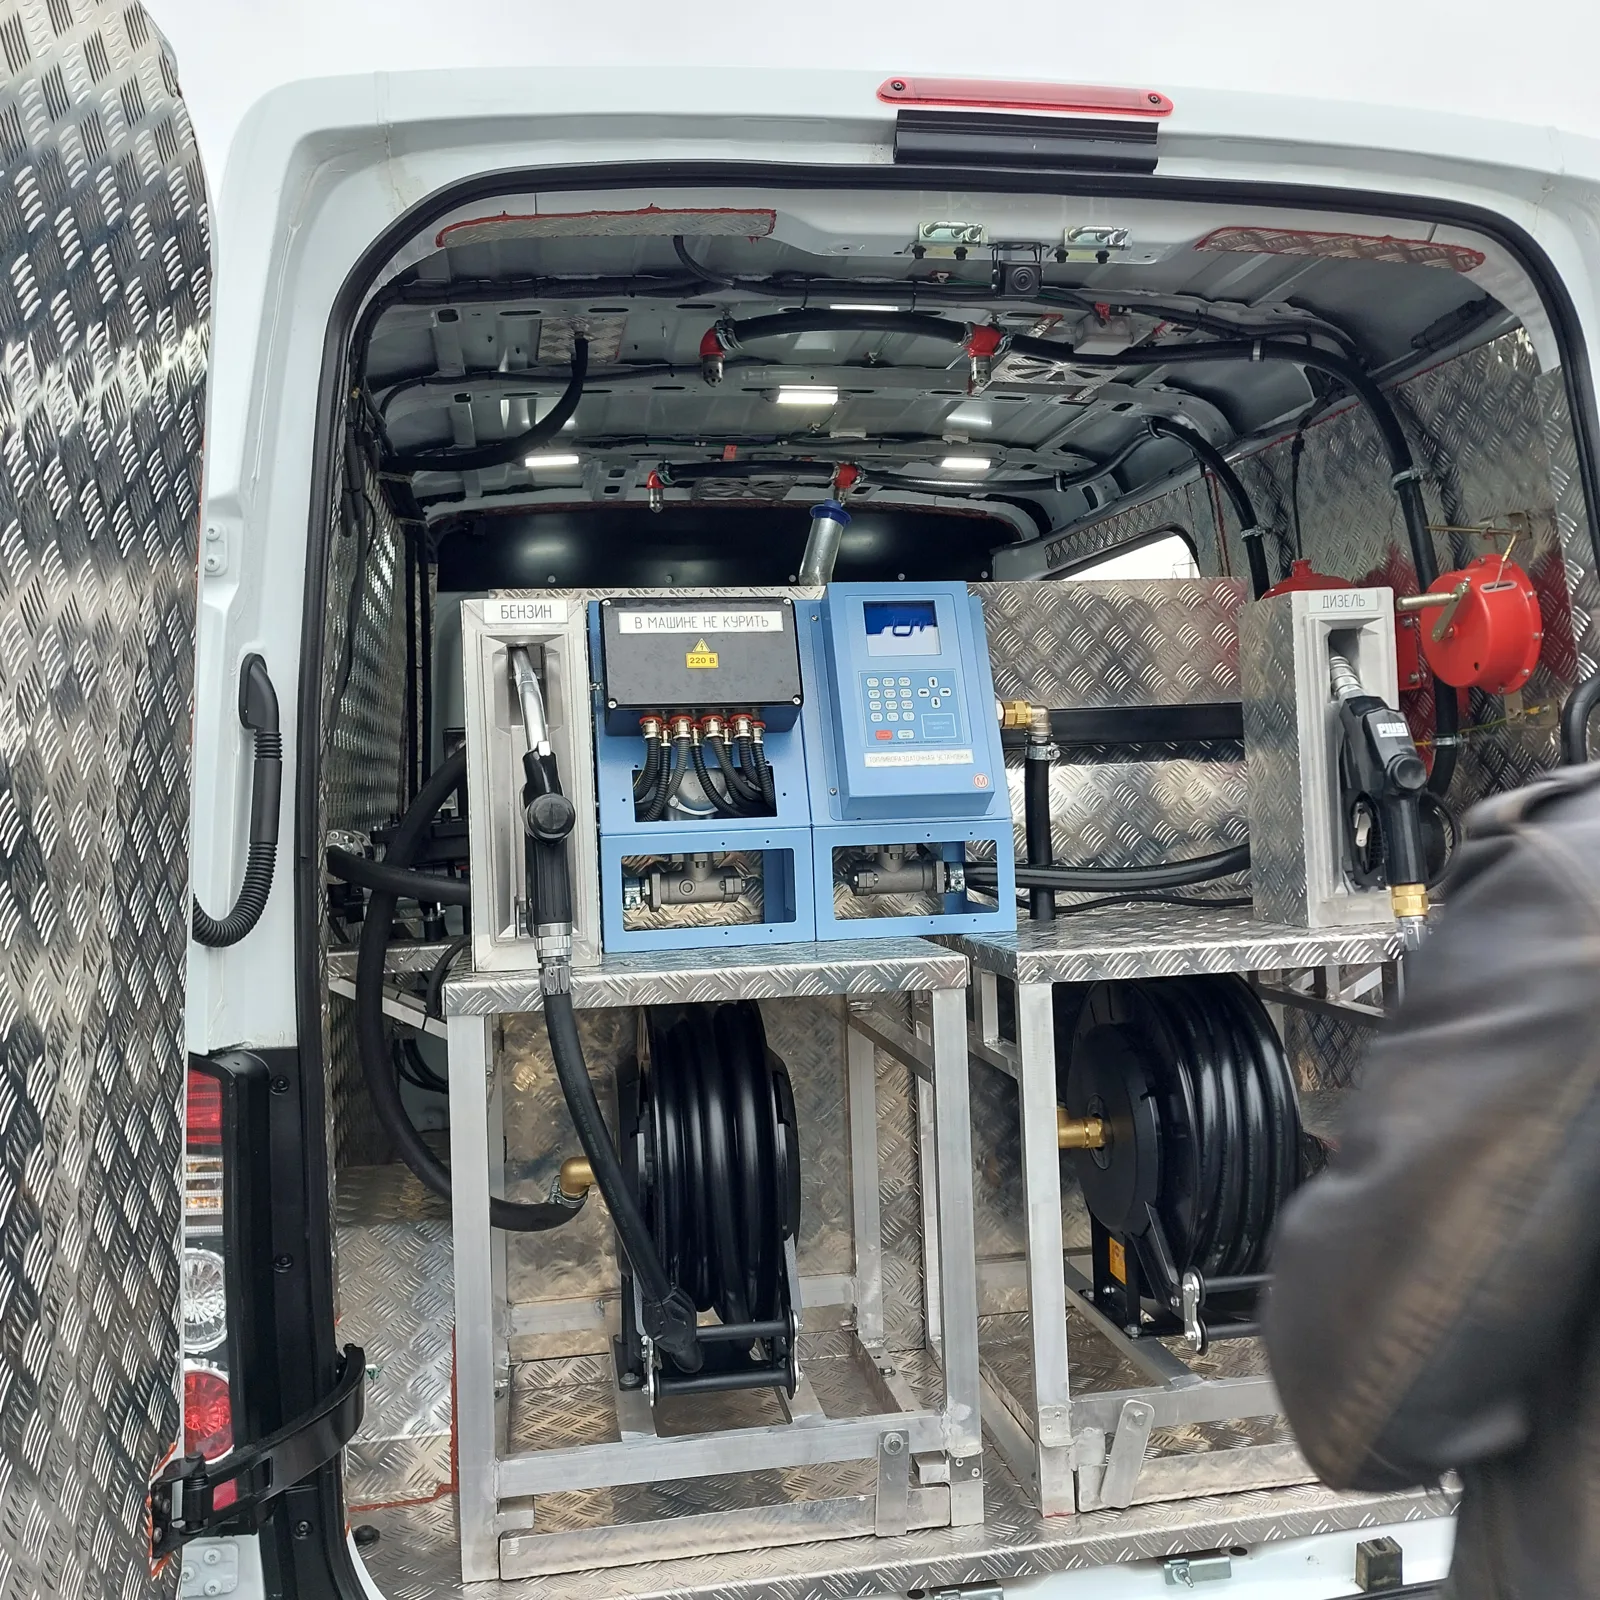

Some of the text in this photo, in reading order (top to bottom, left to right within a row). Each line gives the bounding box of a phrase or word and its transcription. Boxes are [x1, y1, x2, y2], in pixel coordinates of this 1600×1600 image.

[1322, 593, 1366, 609] ДИЗЕЛЬ
[500, 604, 552, 619] БЕНЗИН
[634, 615, 770, 630] В МАШИНЕ НЕ КУРИТЬ
